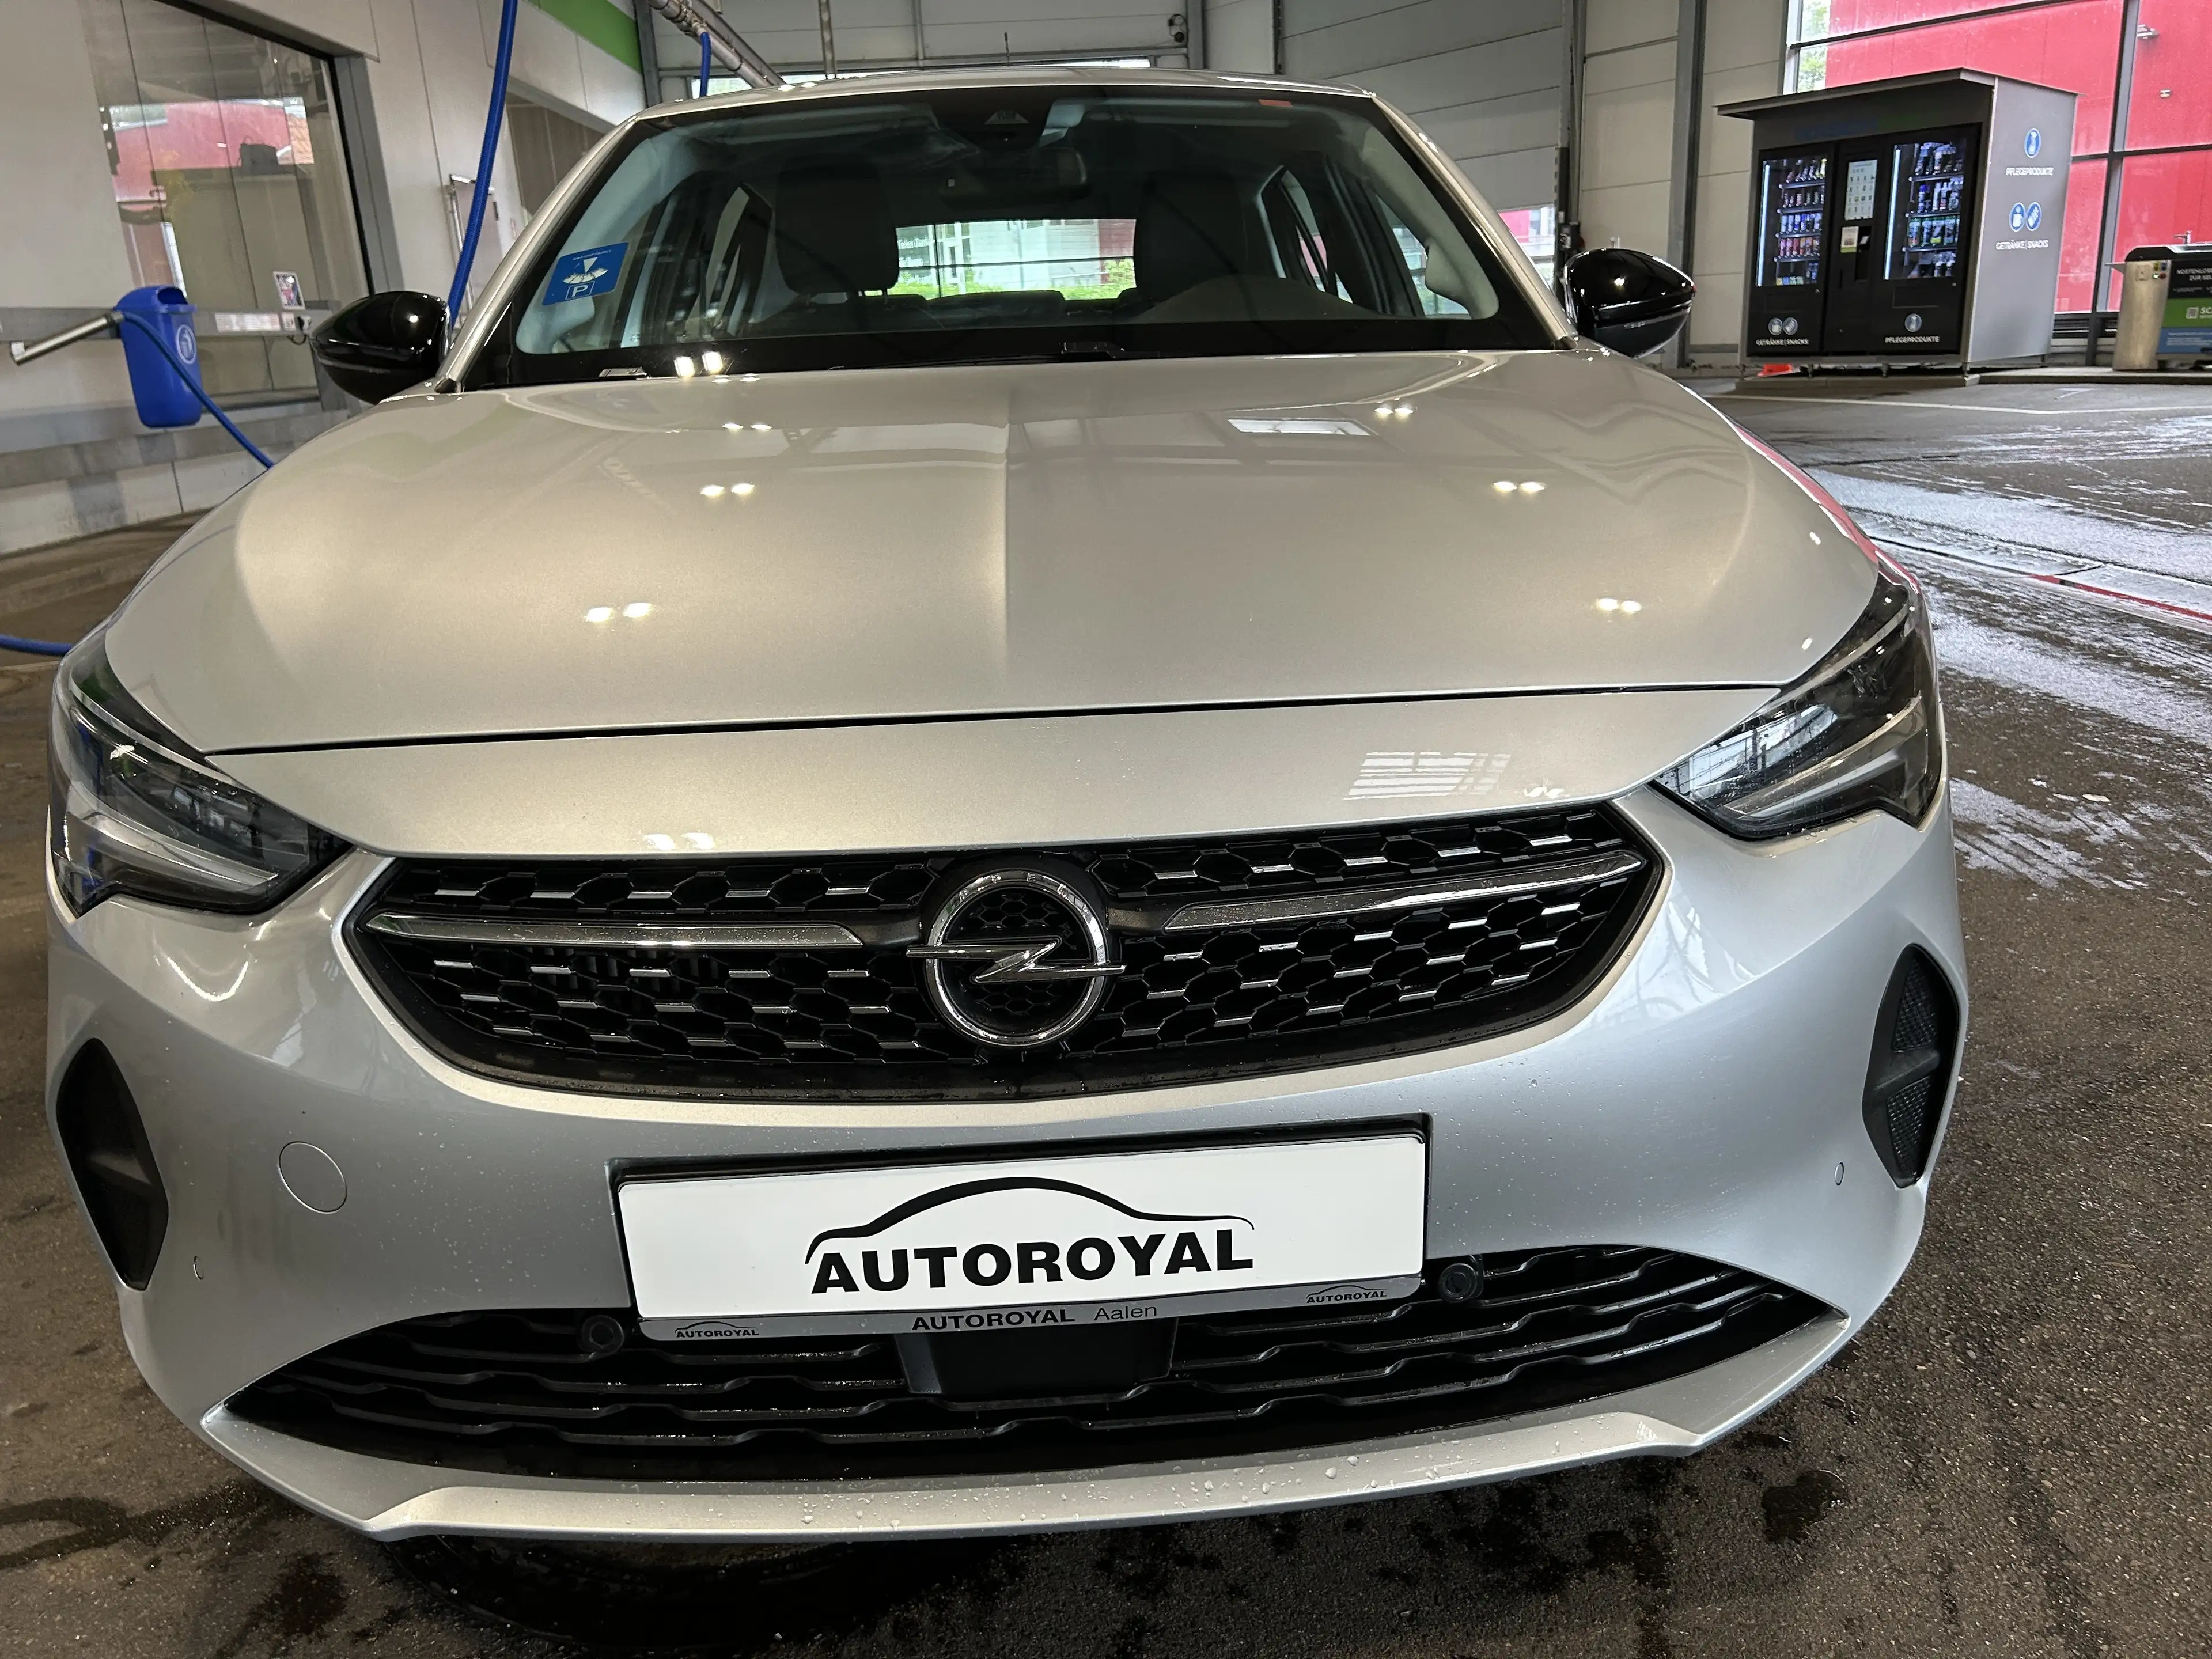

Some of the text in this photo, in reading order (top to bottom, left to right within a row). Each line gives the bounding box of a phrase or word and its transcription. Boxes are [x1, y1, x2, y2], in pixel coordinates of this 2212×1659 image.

[571, 285, 589, 297] P
[811, 1229, 1253, 1294] AUTOROYAL
[1306, 1290, 1387, 1304] AUTOROYAL
[912, 1305, 1157, 1331] AUTOROYAL Aalen
[676, 1329, 760, 1338] AUTOROYAL
